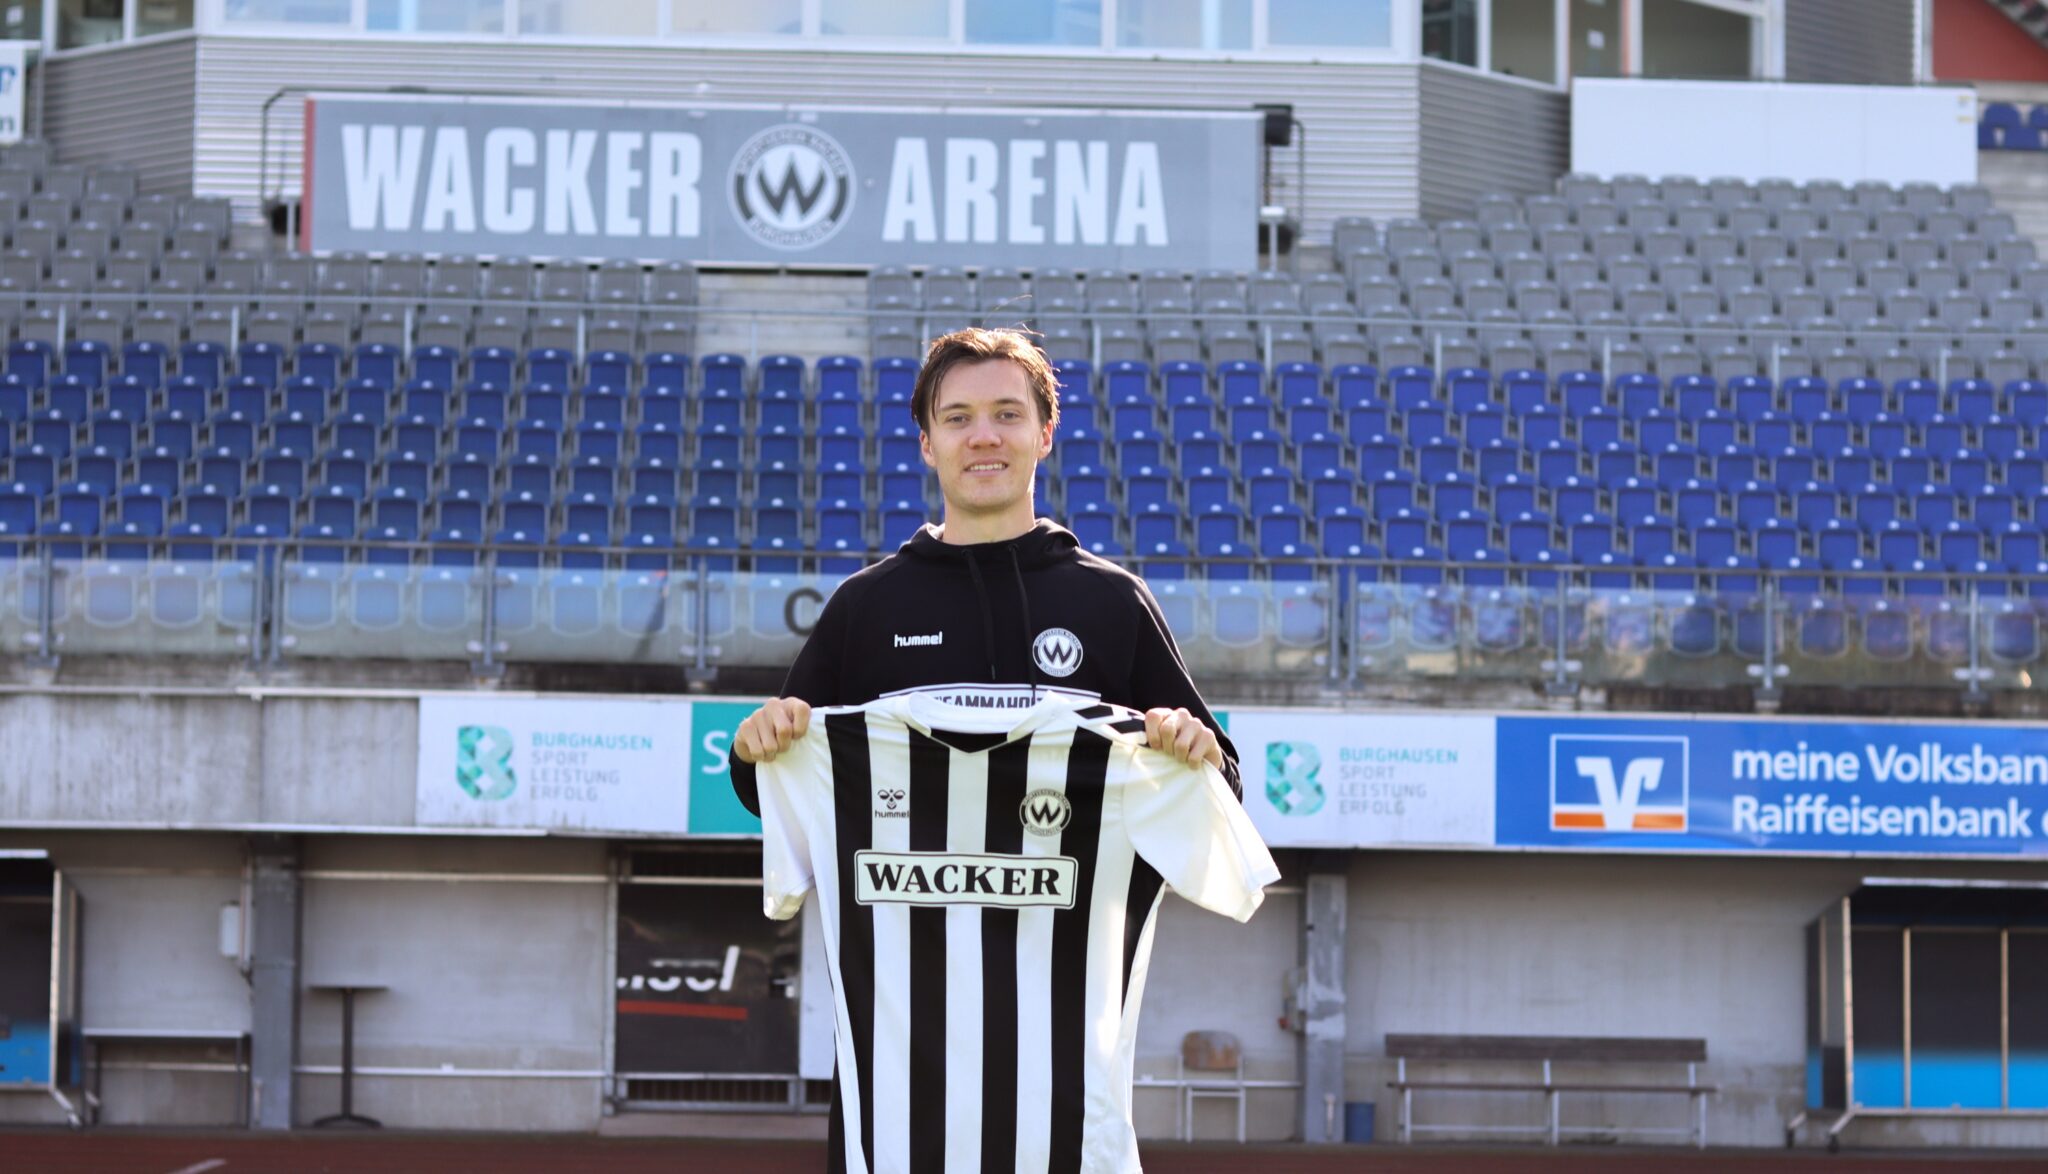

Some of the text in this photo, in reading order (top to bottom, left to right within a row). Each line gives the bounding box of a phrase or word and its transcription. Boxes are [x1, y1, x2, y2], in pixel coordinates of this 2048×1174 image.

[341, 124, 1170, 246] WACKER ARENA
[893, 630, 944, 648] hummel
[933, 695, 1043, 709] AMMAHO
[531, 732, 653, 750] BURGHAUSEN
[531, 751, 589, 765] SPORT
[1339, 747, 1459, 764] BURGHAUSEN
[1732, 741, 2048, 785] meine Volksban
[531, 768, 621, 786] LEISTUNG
[1338, 765, 1396, 780] SPORT
[530, 785, 599, 801] ERFOLG
[1338, 783, 1428, 799] LEISTUNG
[1338, 800, 1406, 816] ERFOLG
[1732, 793, 2034, 838] Raiffeisenbank
[864, 862, 1061, 896] WACKER
